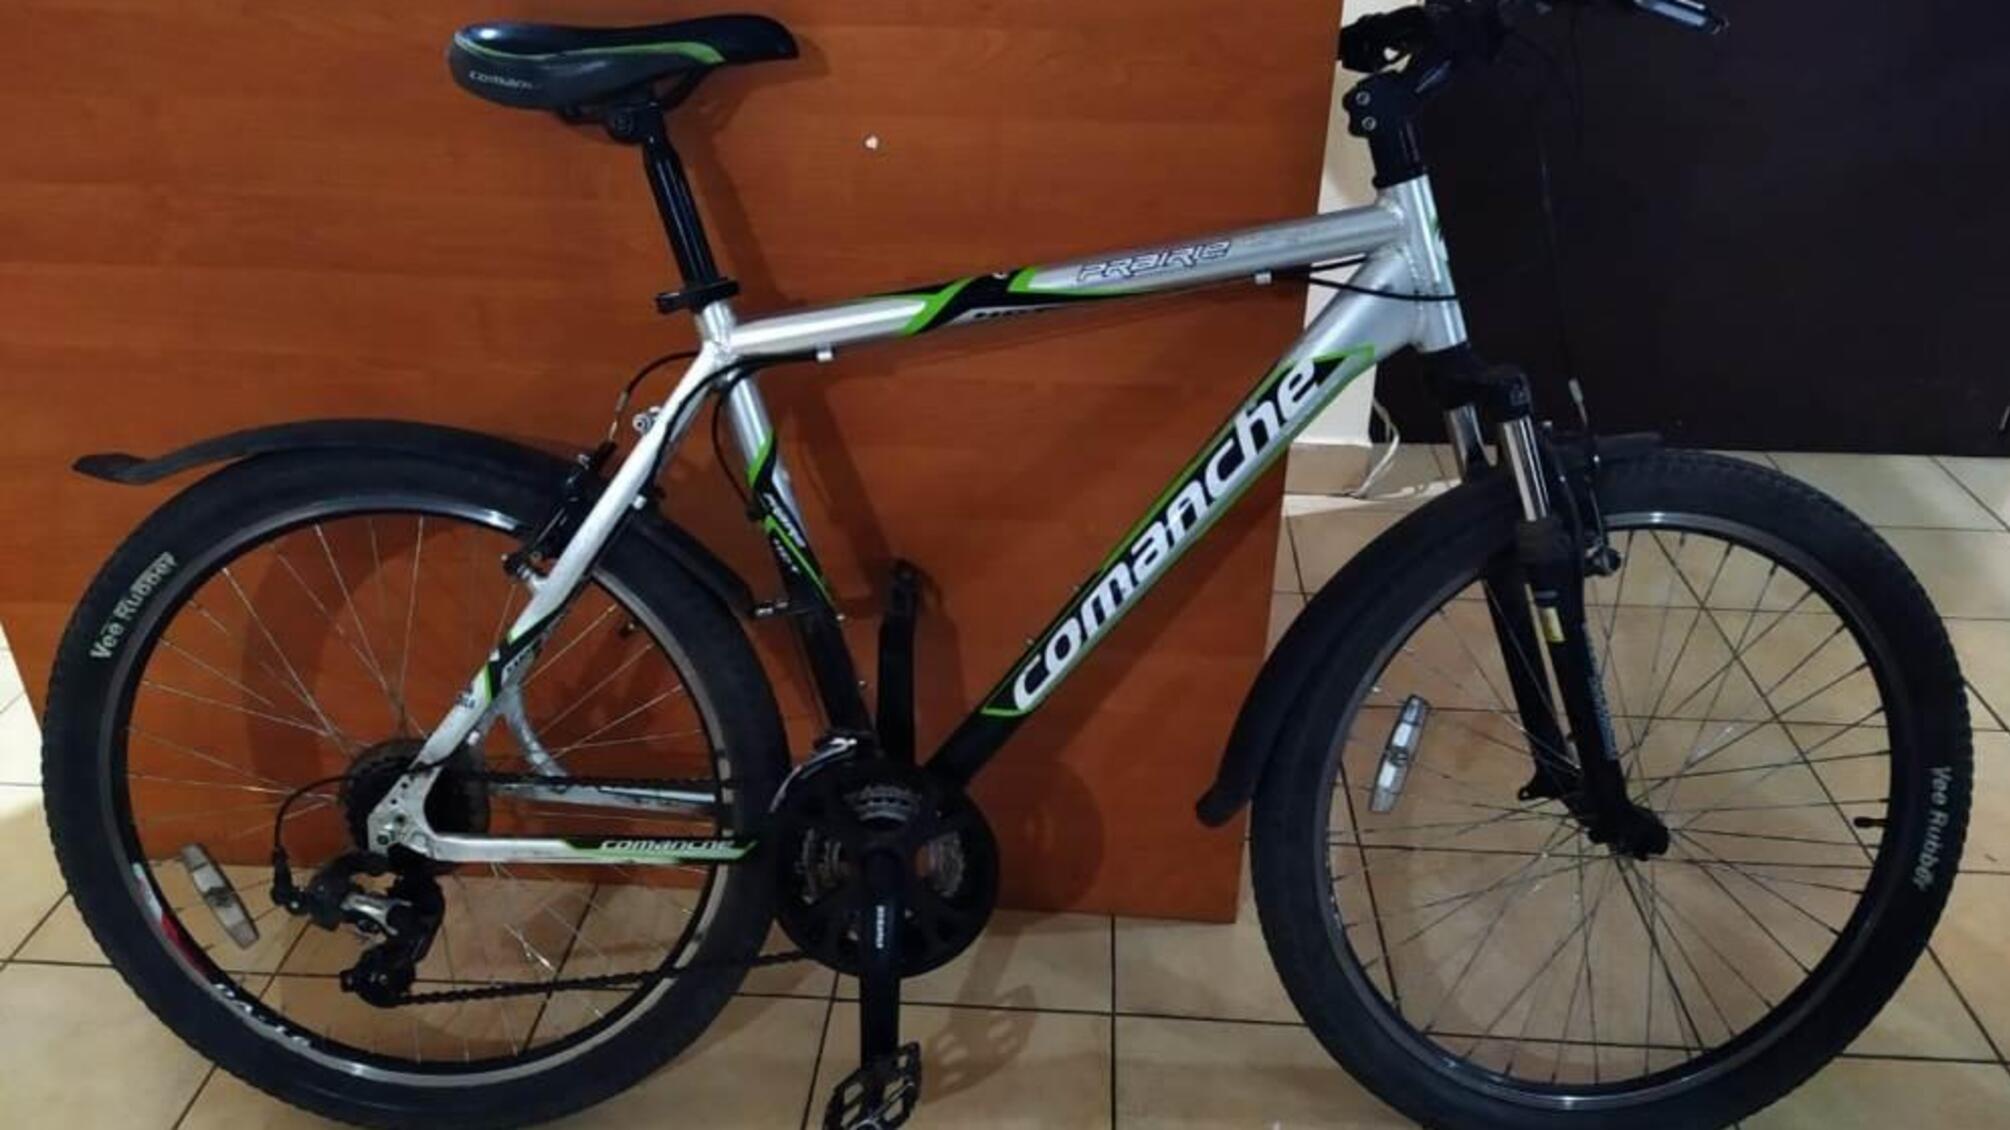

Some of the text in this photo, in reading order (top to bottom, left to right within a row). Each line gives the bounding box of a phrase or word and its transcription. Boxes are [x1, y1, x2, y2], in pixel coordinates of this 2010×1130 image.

[89, 552, 177, 658] Vee Rubber
[1013, 357, 1315, 711] comanche
